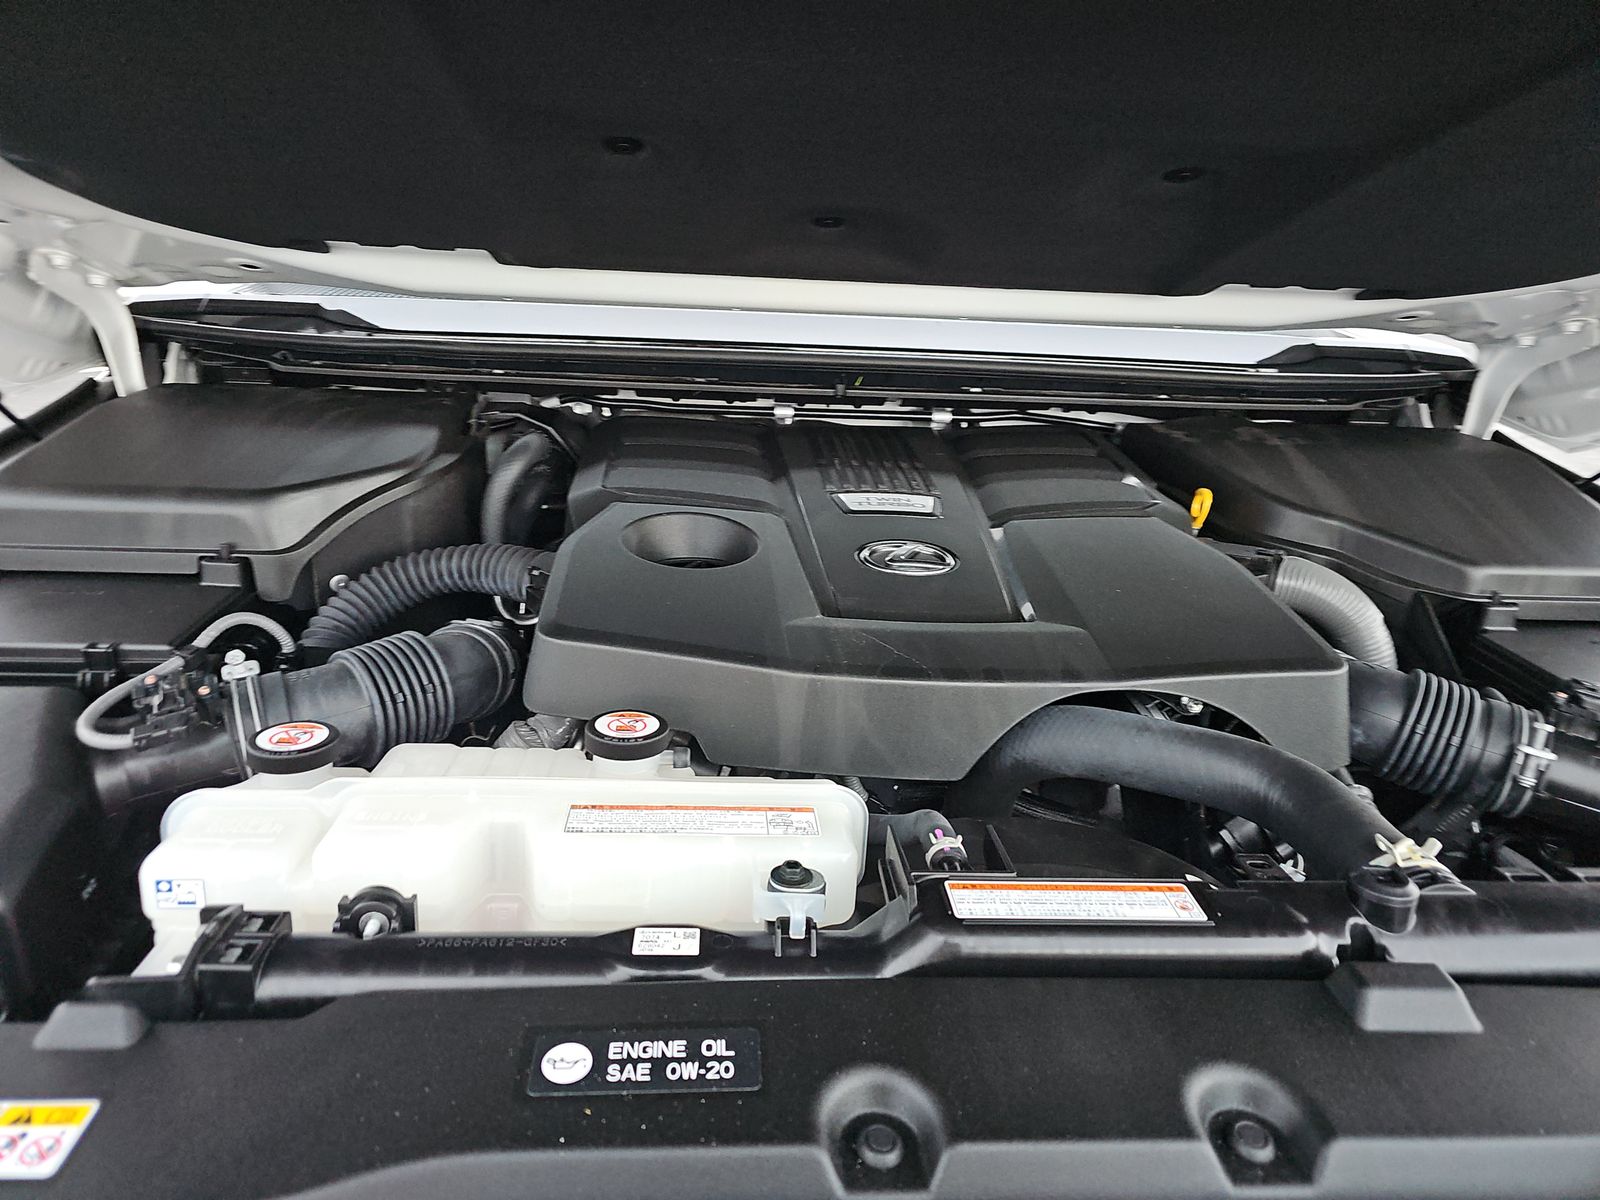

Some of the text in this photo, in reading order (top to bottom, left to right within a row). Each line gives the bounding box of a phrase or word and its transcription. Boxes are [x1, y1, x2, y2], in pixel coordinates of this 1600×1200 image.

[607, 1038, 735, 1060] ENGINE OIL
[605, 1061, 735, 1083] SAE 0W-20
